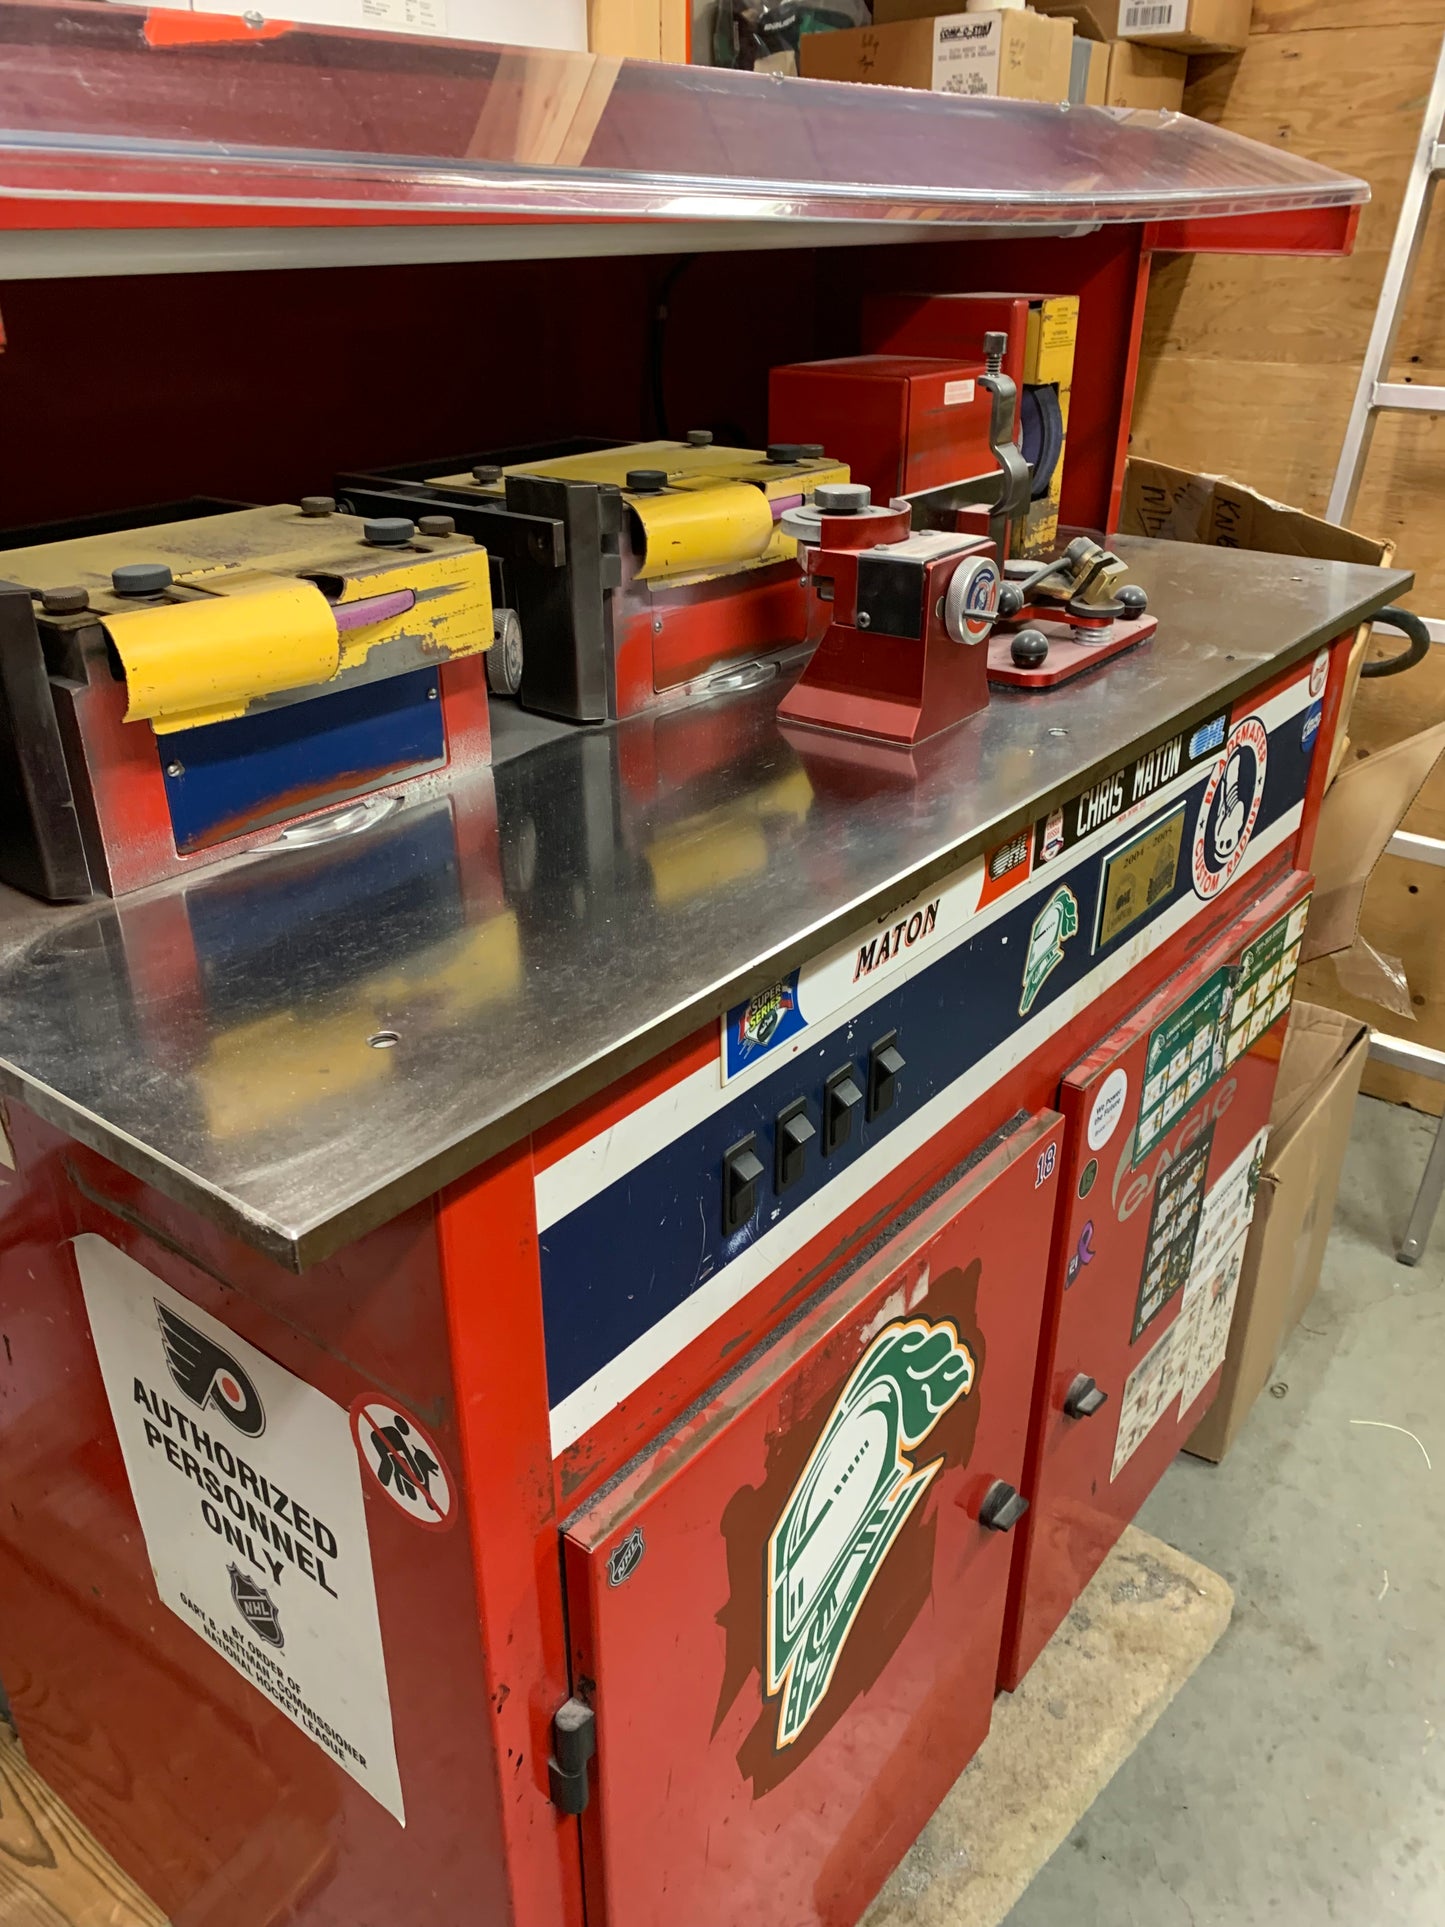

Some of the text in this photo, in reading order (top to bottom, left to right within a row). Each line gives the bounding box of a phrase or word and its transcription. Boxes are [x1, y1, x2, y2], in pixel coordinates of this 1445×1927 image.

[1077, 734, 1183, 838] CHRIS MATON
[1204, 719, 1267, 804] BLADEMASTER
[1194, 797, 1261, 893] CUSTOM RADIUS
[853, 899, 941, 984] MATON
[748, 996, 782, 1033] SERIES
[751, 984, 782, 1015] SUPER
[1035, 1142, 1057, 1189] 18
[1068, 1255, 1079, 1276] 21
[134, 1377, 338, 1559] AUTHORIZED
[143, 1418, 338, 1599] PERSONNEL
[201, 1499, 285, 1586] ONLY
[617, 1543, 639, 1578] NHL
[243, 1600, 271, 1617] NHL
[180, 1592, 206, 1620] GARY
[277, 1680, 368, 1769] COMMISSIONER
[203, 1624, 346, 1762] NATIONAL HOCKEY LEAGUE
[231, 1626, 302, 1694] BY ORDER OF
